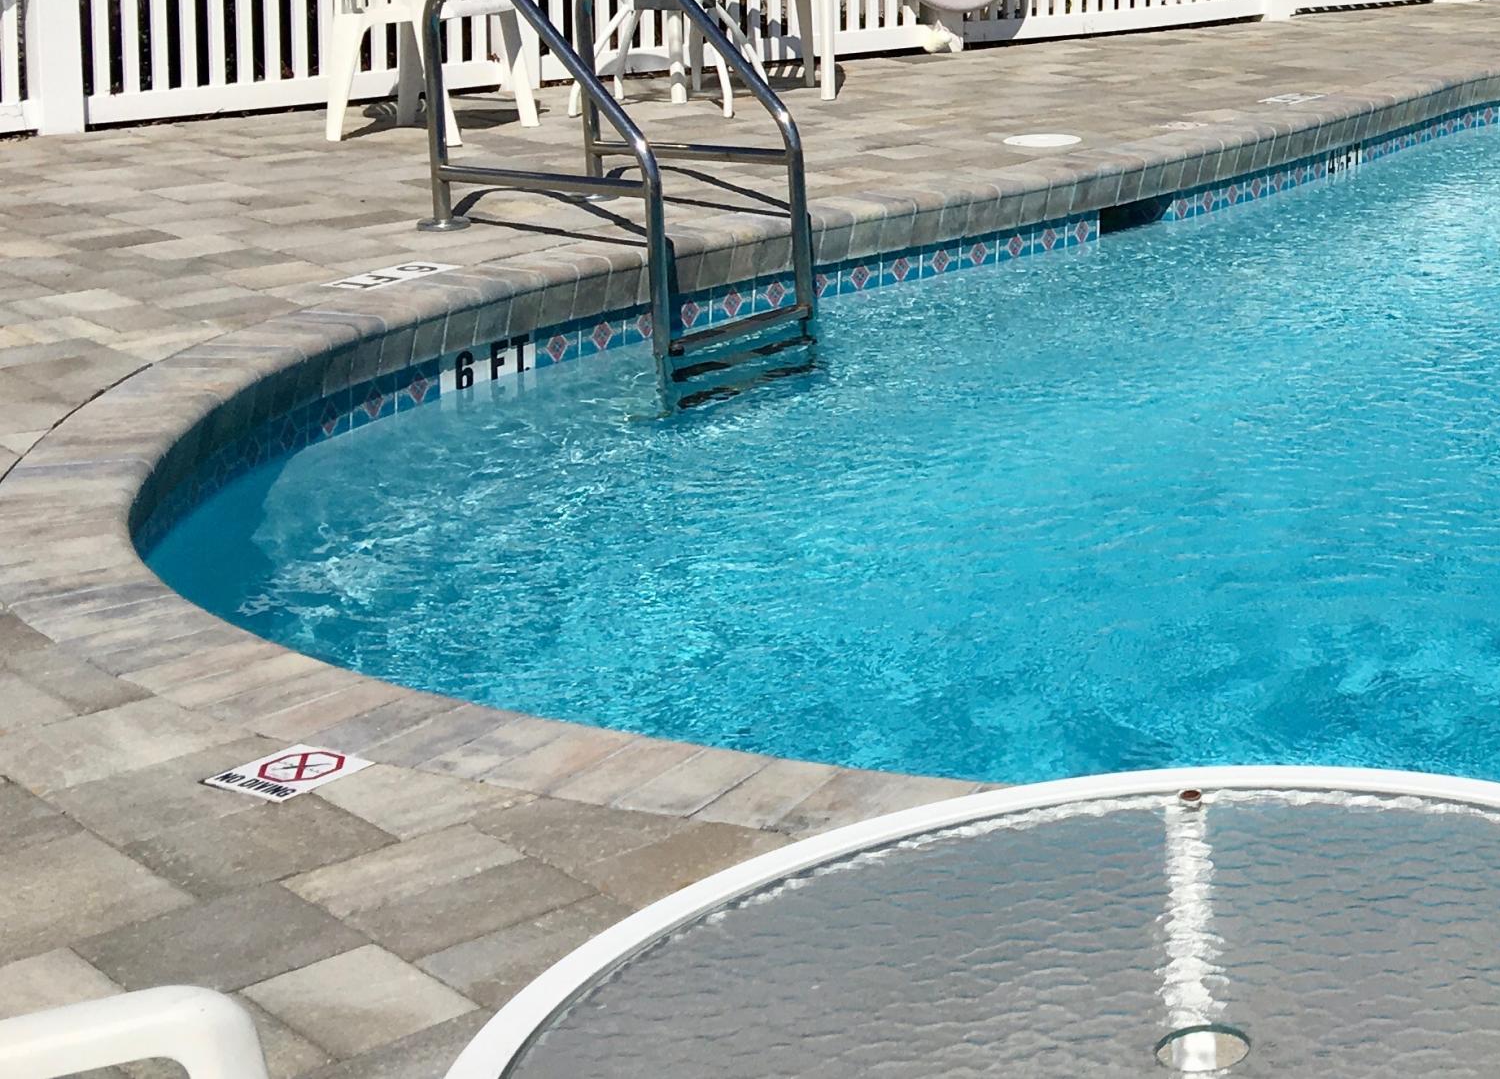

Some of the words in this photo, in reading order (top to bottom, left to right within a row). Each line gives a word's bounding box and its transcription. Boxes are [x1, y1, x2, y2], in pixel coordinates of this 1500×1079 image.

[1346, 141, 1361, 169] FT
[455, 350, 474, 390] 6
[215, 772, 245, 784] NO
[242, 778, 297, 798] DIVING
